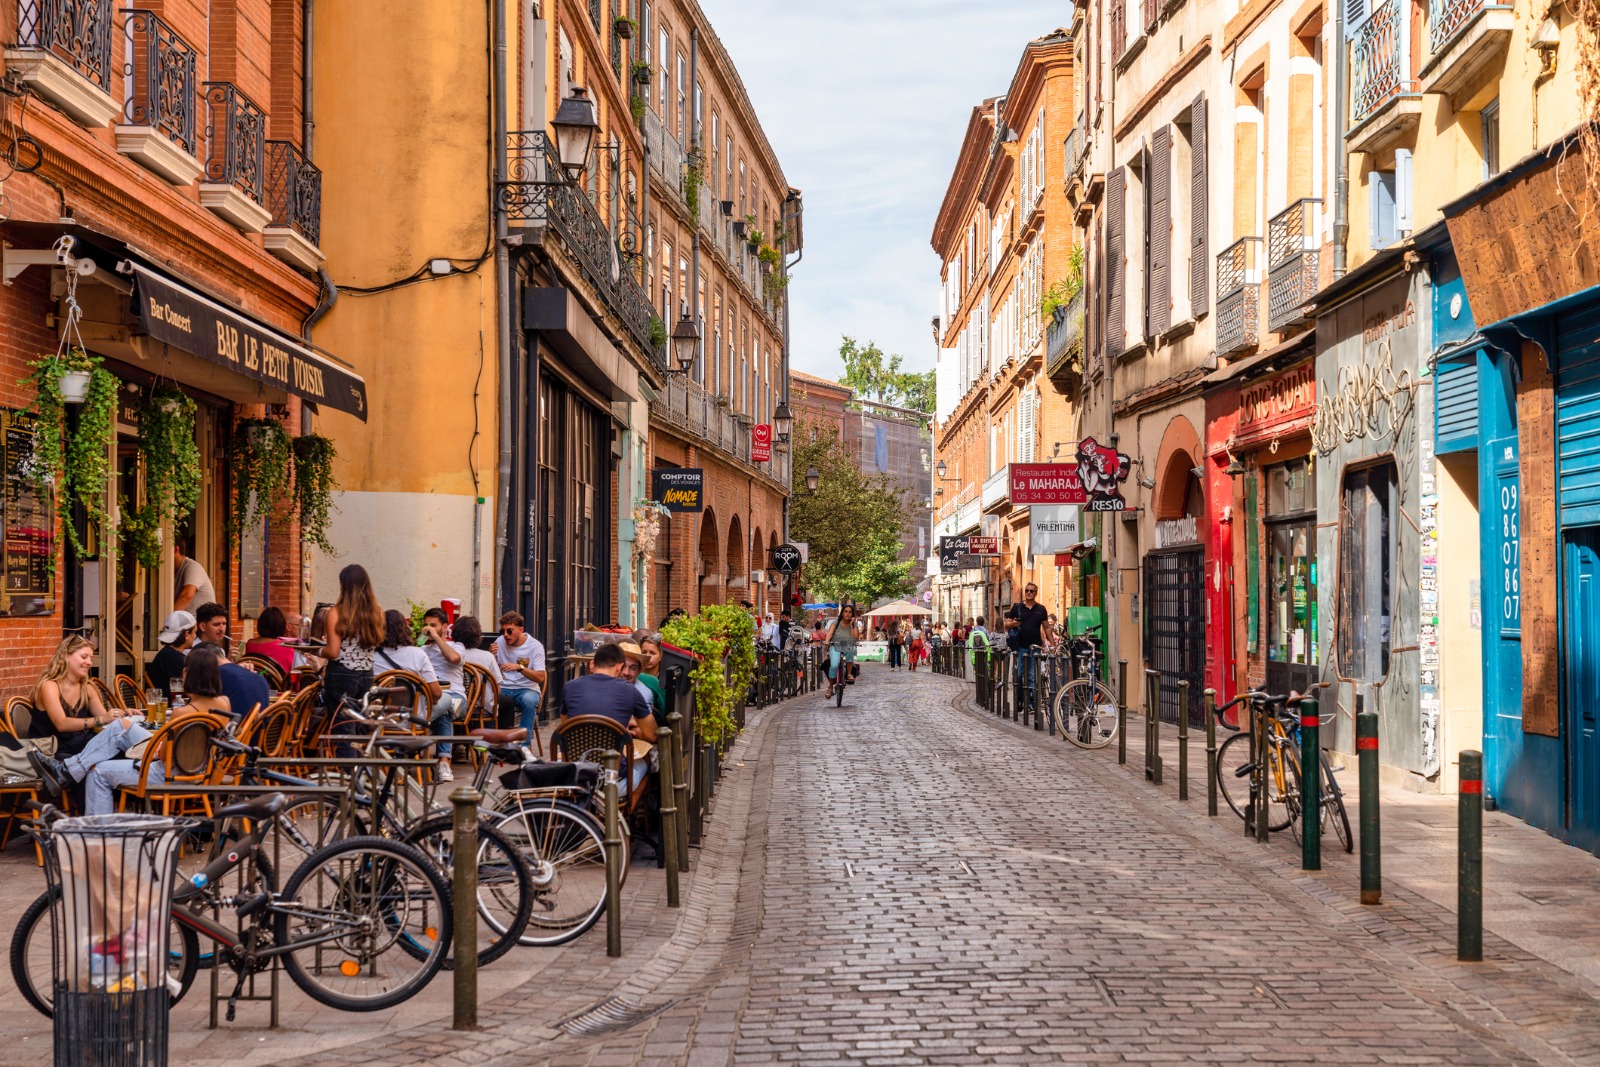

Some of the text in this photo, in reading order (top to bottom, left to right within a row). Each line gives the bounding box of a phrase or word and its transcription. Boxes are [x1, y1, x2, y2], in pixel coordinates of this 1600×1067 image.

[150, 297, 192, 333] Bar Concert
[216, 320, 239, 363] BAR
[244, 334, 258, 371] LE
[262, 342, 290, 383] PETIT
[293, 357, 324, 397] VOISIN
[1014, 479, 1025, 490] Le
[1016, 468, 1077, 477] Restaurant Indie
[662, 488, 698, 504] NOMADE
[1016, 492, 1082, 500] 05 34 30 50 12
[1092, 499, 1123, 510] RESTO
[1502, 485, 1516, 510] 09
[1504, 513, 1516, 537] 86
[954, 539, 969, 548] Cav
[1503, 540, 1518, 565] 07
[1504, 568, 1518, 593] 86
[1504, 596, 1519, 620] 07
